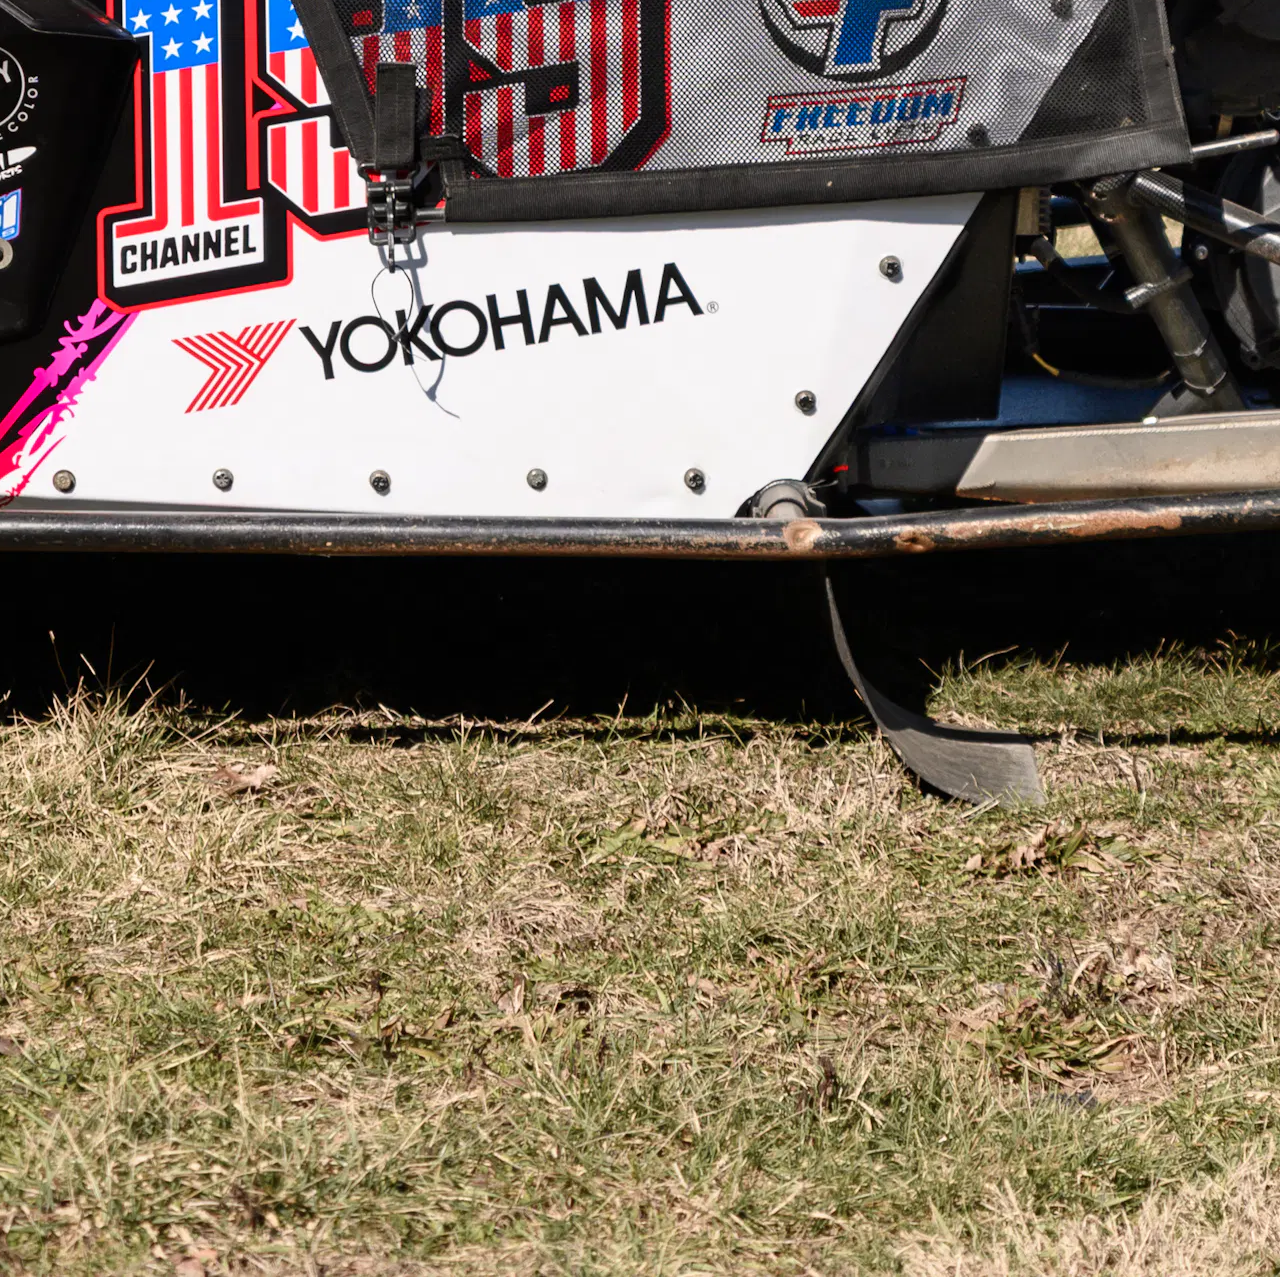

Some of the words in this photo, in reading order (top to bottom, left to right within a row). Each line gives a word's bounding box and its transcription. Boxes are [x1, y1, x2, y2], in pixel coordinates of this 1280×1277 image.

[7, 75, 39, 133] COLOR
[770, 92, 954, 133] FREEDOM
[120, 224, 257, 276] CHANNEL
